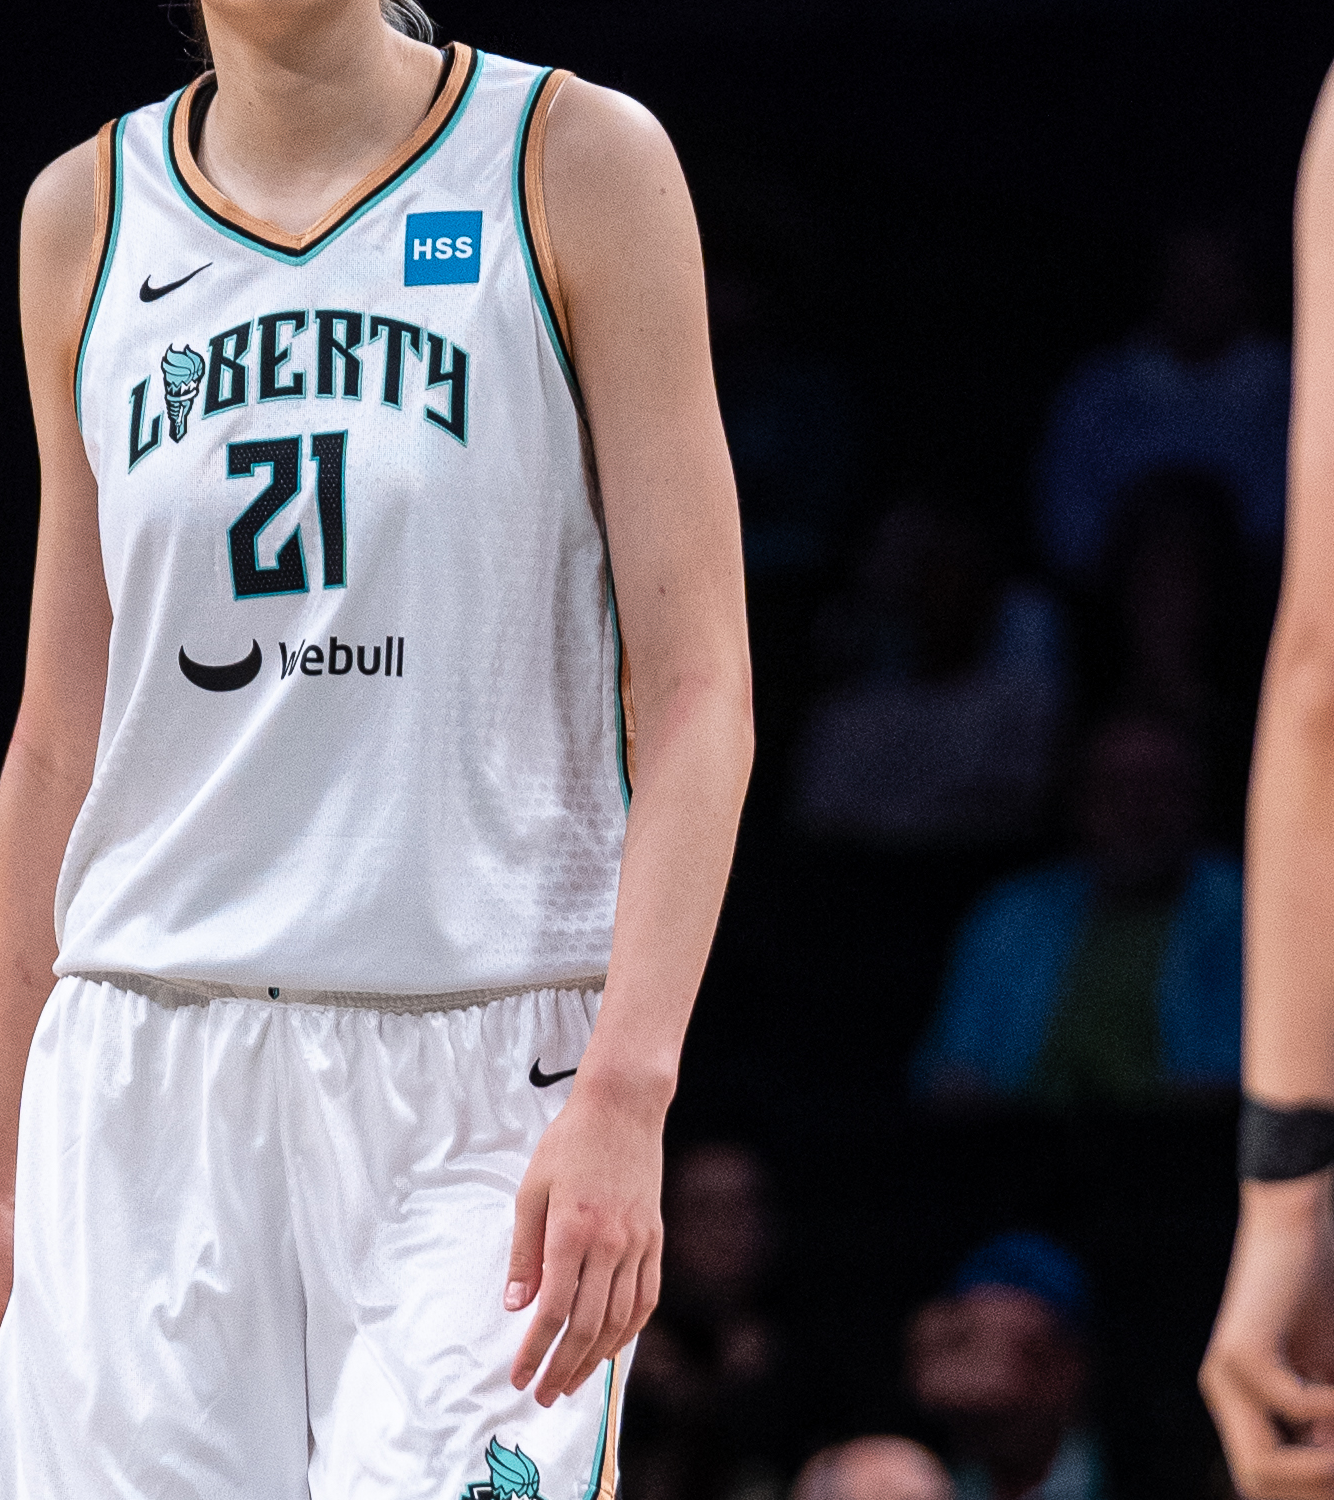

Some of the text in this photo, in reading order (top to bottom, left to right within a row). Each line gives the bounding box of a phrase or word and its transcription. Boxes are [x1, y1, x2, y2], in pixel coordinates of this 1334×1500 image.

[412, 236, 473, 260] HSS
[128, 309, 469, 474] LIBERTY
[226, 429, 348, 601] 21
[278, 635, 405, 680] Webull
